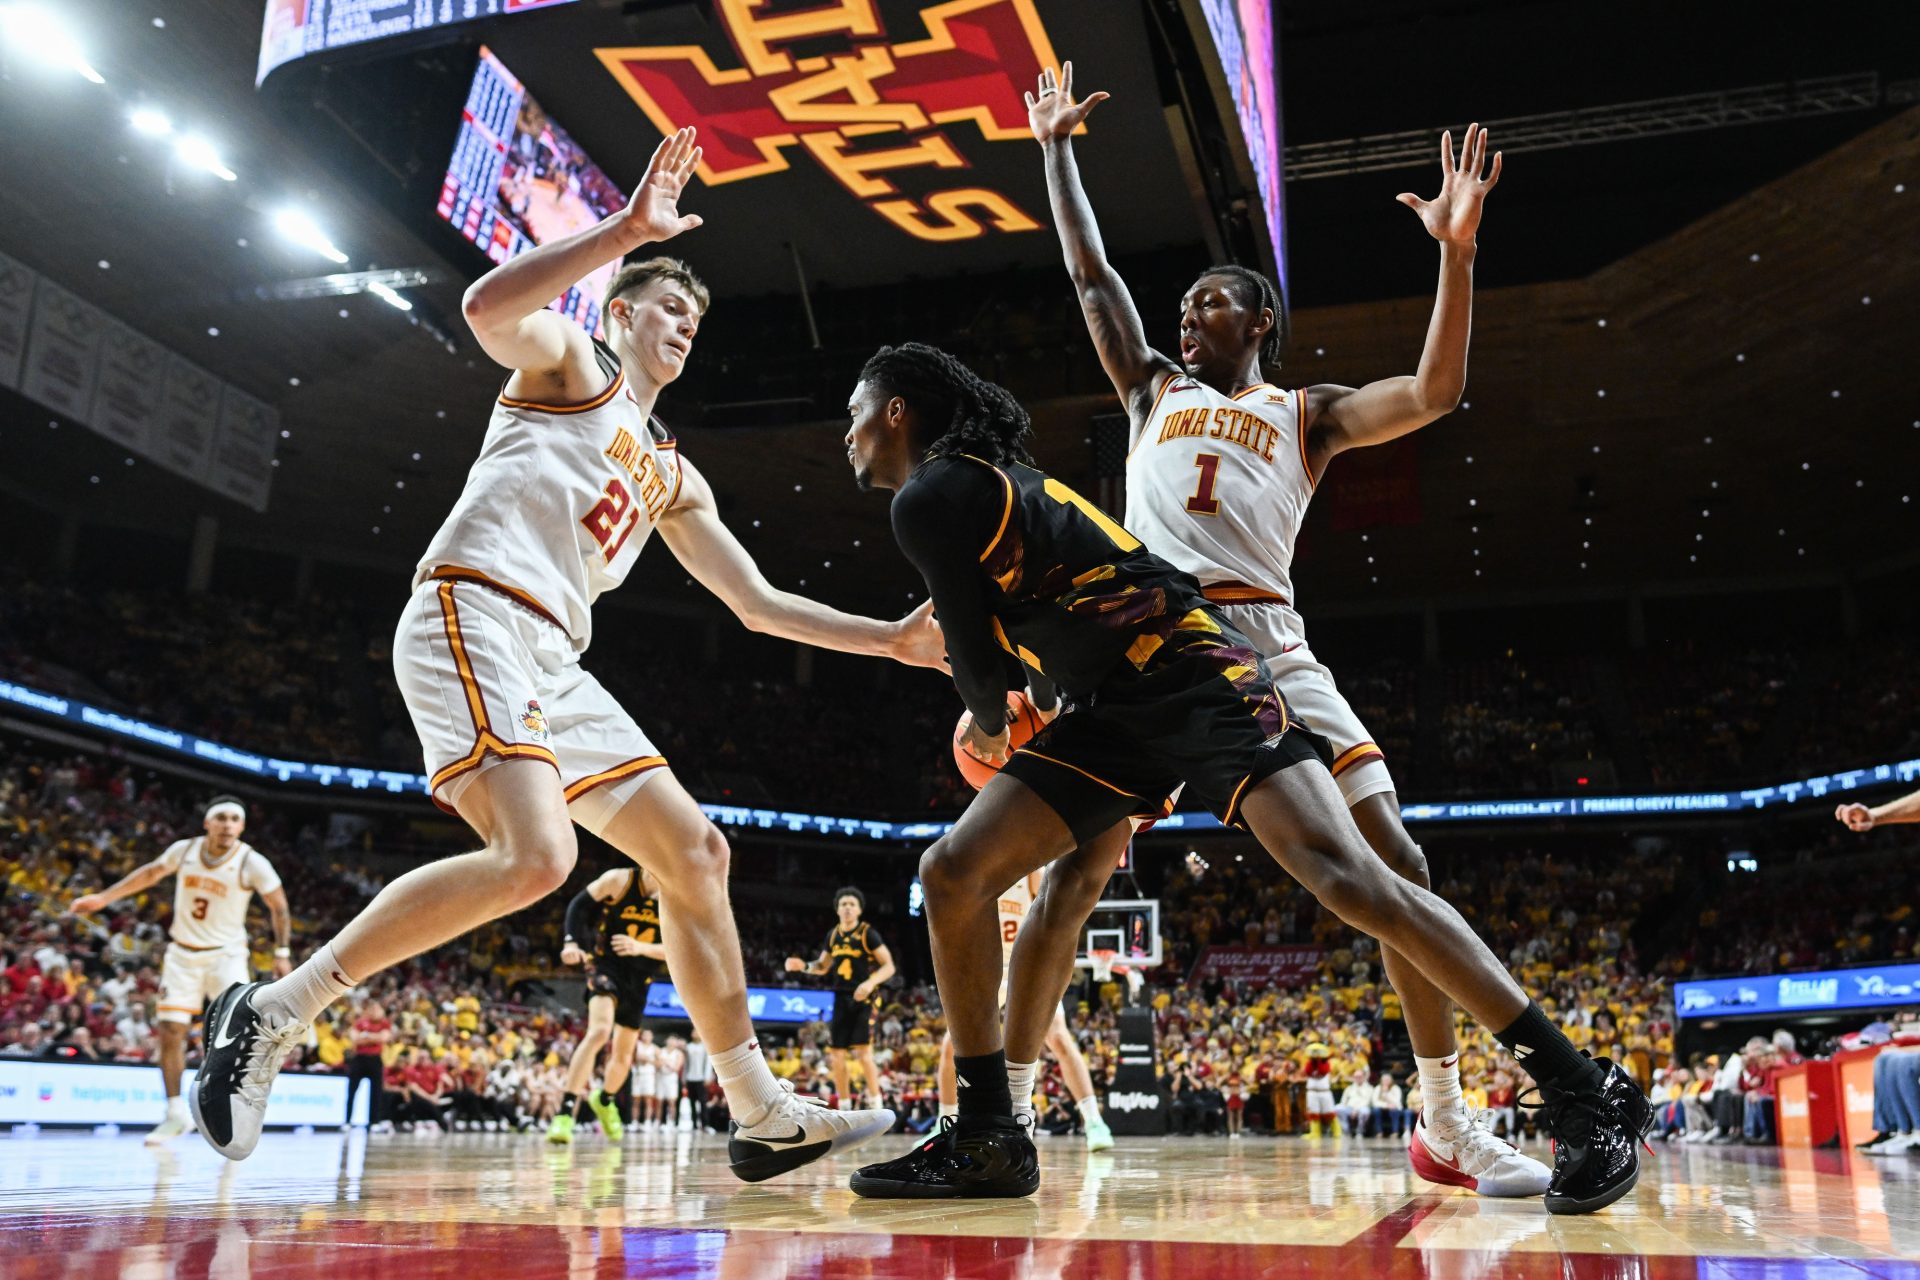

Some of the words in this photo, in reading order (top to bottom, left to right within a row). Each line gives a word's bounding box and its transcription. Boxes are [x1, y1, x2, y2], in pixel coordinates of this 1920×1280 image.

[714, 0, 1046, 243] STAT
[1157, 408, 1209, 446] IOWA
[1210, 408, 1280, 465] STATE
[604, 426, 641, 474] IOWA
[633, 453, 668, 524] STATE
[1186, 453, 1221, 517] 1
[580, 478, 640, 567] 21
[1450, 801, 1565, 817] CHEVROLET
[1583, 797, 1634, 812] PREMIER
[1635, 796, 1674, 811] CHEVY
[1675, 794, 1728, 810] DEALERS
[191, 897, 209, 921] 3
[837, 958, 853, 981] 4
